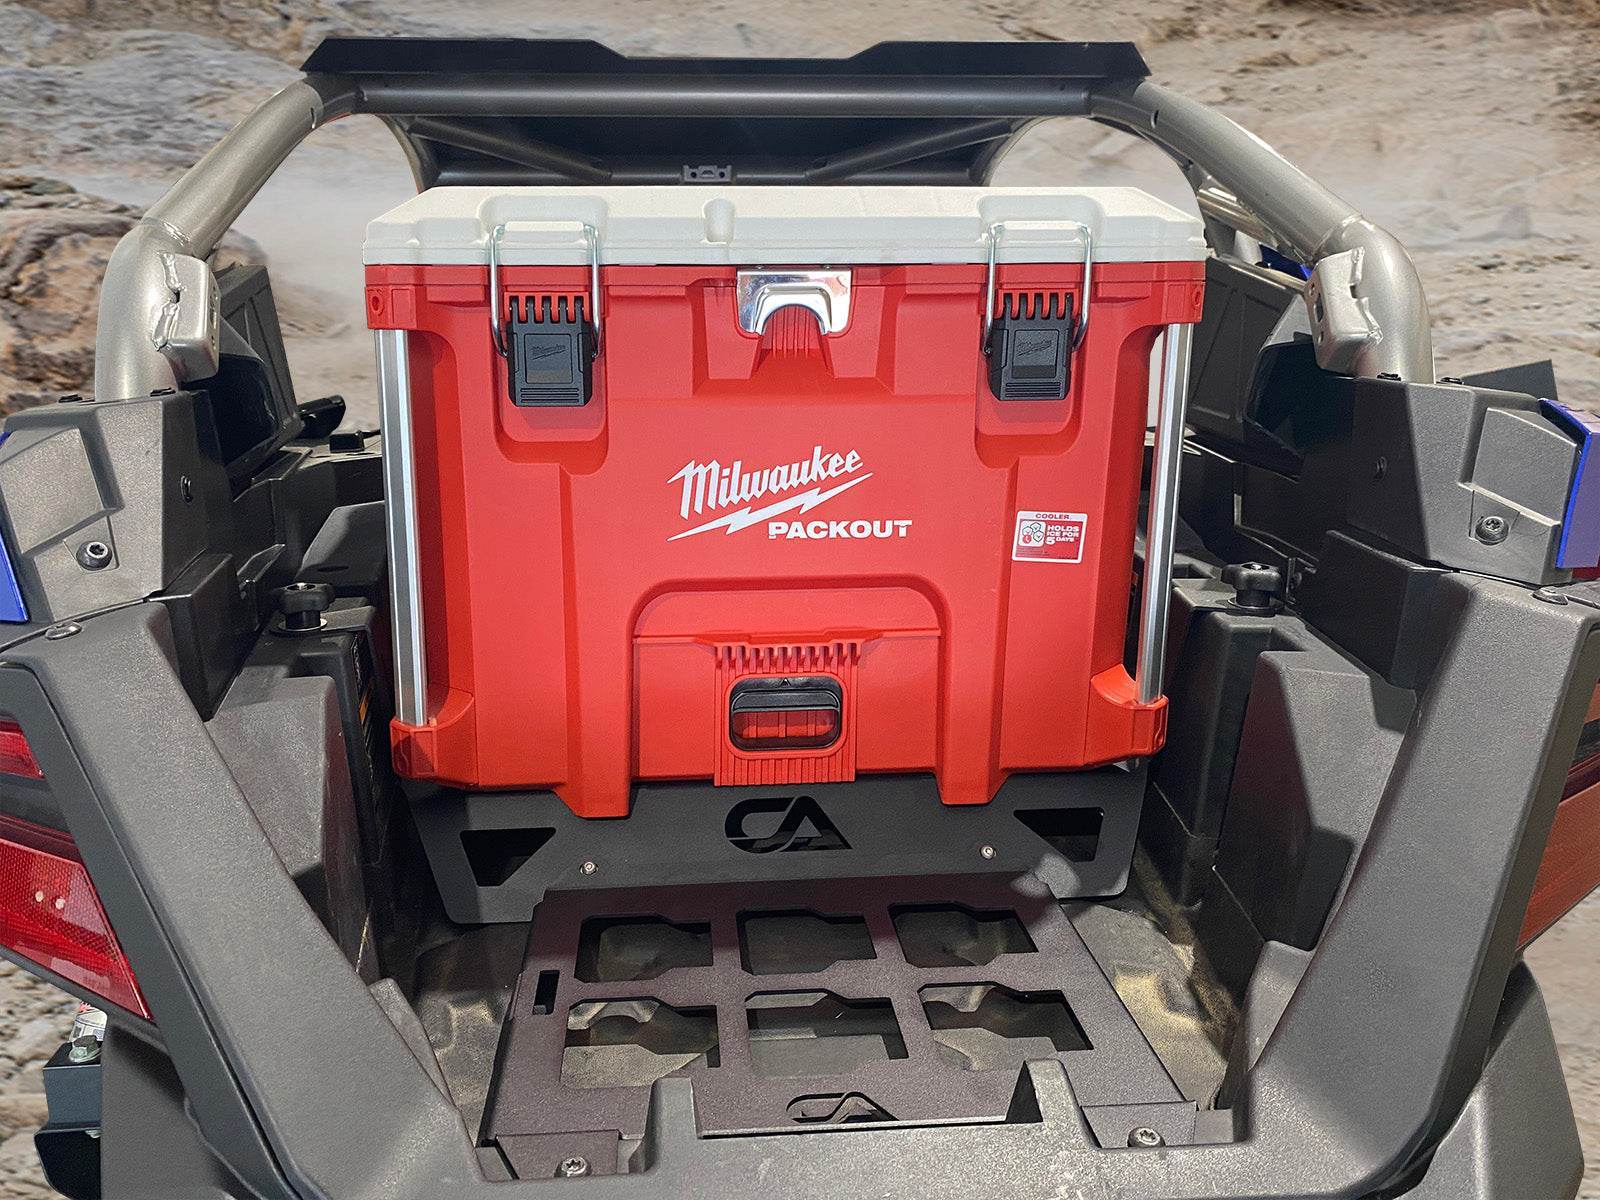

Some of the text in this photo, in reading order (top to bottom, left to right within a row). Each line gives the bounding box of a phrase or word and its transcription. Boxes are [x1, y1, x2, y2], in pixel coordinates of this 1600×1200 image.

[667, 445, 863, 520] Milwaukee
[768, 519, 912, 540] PACKOUT
[1045, 537, 1056, 545] 5
